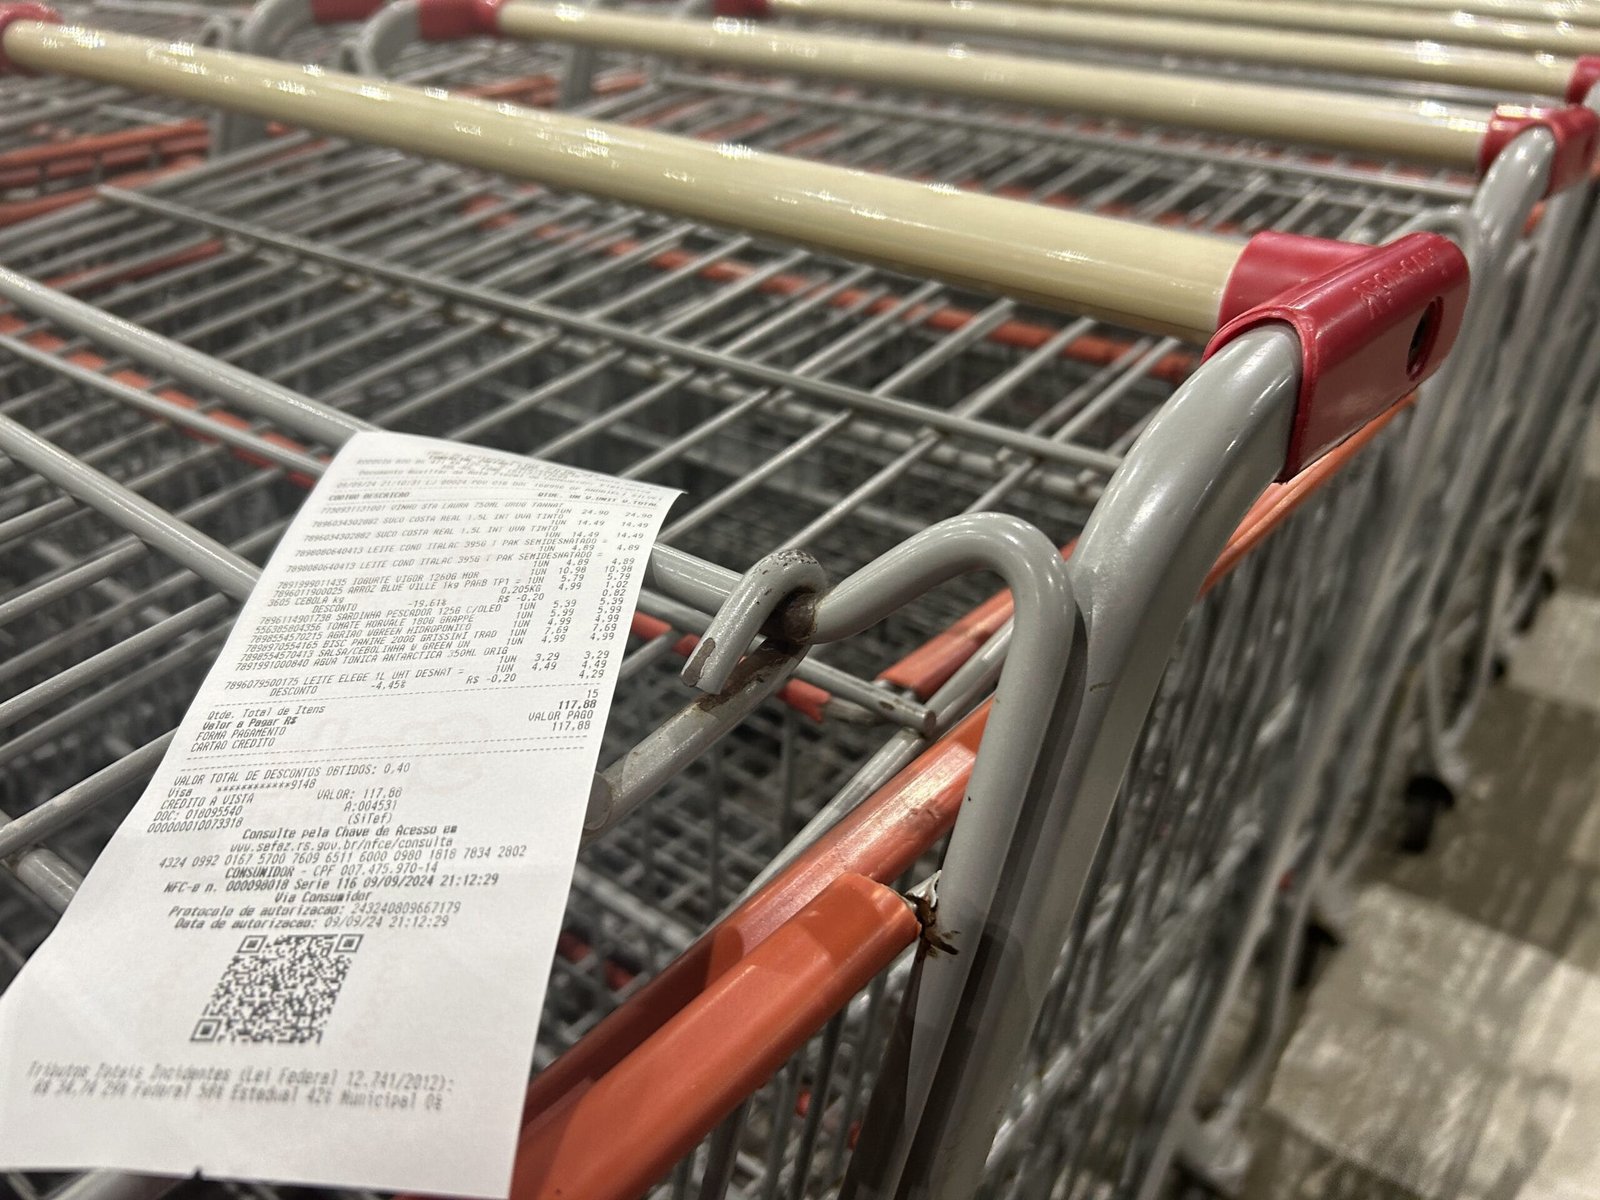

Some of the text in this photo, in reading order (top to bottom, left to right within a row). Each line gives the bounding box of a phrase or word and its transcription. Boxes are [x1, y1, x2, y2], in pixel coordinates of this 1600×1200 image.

[382, 516, 405, 524] SUCO
[409, 515, 436, 523] COSTA
[375, 530, 398, 539] SUCO
[401, 529, 429, 537] COSTA
[368, 544, 395, 553] LEITE
[502, 539, 519, 547] PAK
[524, 537, 597, 546] SEMIDESNATADO
[360, 559, 388, 569] LEITE
[420, 556, 453, 565] ITALAC
[496, 553, 514, 561] PAK
[520, 551, 592, 560] SEMIDESNATADO
[352, 575, 391, 586] IOGURTE
[396, 574, 424, 583] VIGOR
[461, 571, 480, 580] MOR
[347, 584, 377, 594] ARROZ
[380, 583, 404, 592] BLUE
[409, 581, 438, 590] VILLE
[294, 596, 329, 606] CEBOLA
[312, 603, 358, 614] DESCONTO
[336, 610, 381, 620] SARDINHA
[386, 608, 433, 618] PESCADOR
[327, 621, 360, 631] TOMATE
[327, 623, 471, 639] AGRIAO HIDROPONICO
[322, 630, 497, 649] BISC PANINE 200G GRISSINI TRAD
[422, 640, 453, 650] GREEN
[313, 656, 338, 666] AGUA
[343, 654, 378, 664] TONICA
[382, 650, 443, 662] ANTARCTICA
[483, 646, 509, 656] ORIG
[303, 675, 335, 685] LEITE
[338, 672, 370, 683] ELEGE
[391, 670, 411, 680] UHT
[415, 667, 453, 678] DESNAT
[270, 675, 479, 697] DESCONTO R$
[207, 689, 599, 720] Qtde. Total de Itens 15
[196, 709, 594, 741] FORMA PAGAMENTO VALOR PAGO
[202, 720, 232, 730] Valor
[236, 721, 245, 729] a
[248, 718, 280, 728] Pagar
[283, 716, 298, 725] R$
[191, 740, 227, 752] CARTAO
[232, 737, 275, 749] CREDITO
[174, 764, 377, 786] VALOR TOTAL DE DESCONTOS OBTIDOS:
[160, 789, 355, 810] CREDITO A VISTA VALOR:
[168, 788, 193, 798] Visa
[153, 810, 180, 821] DOC:
[343, 800, 398, 812] A:004531
[348, 812, 392, 825] (SiTef)
[242, 824, 457, 839] Consulte pela Chave de Acesso em
[230, 837, 453, 852] www.sefaz.rs.gov.br/nfce/consulta
[160, 856, 188, 868] 4324
[192, 855, 220, 867] 0992
[257, 852, 286, 864] 5700
[498, 845, 527, 858] 2802
[225, 866, 295, 879] CONSUMIDOR
[313, 864, 336, 876] CPF
[164, 881, 201, 893] NFC-e
[294, 878, 330, 890] Serie
[337, 877, 357, 889] 116
[363, 875, 434, 888] 09/09/2024
[440, 872, 499, 887] 21:12:29
[275, 890, 372, 903] Via Consumidor
[168, 905, 234, 917] Protocolo
[240, 905, 255, 916] de
[260, 904, 345, 916] autorizacao:
[174, 914, 449, 929] Data de autorizacao: 09/09/24 21:12:29
